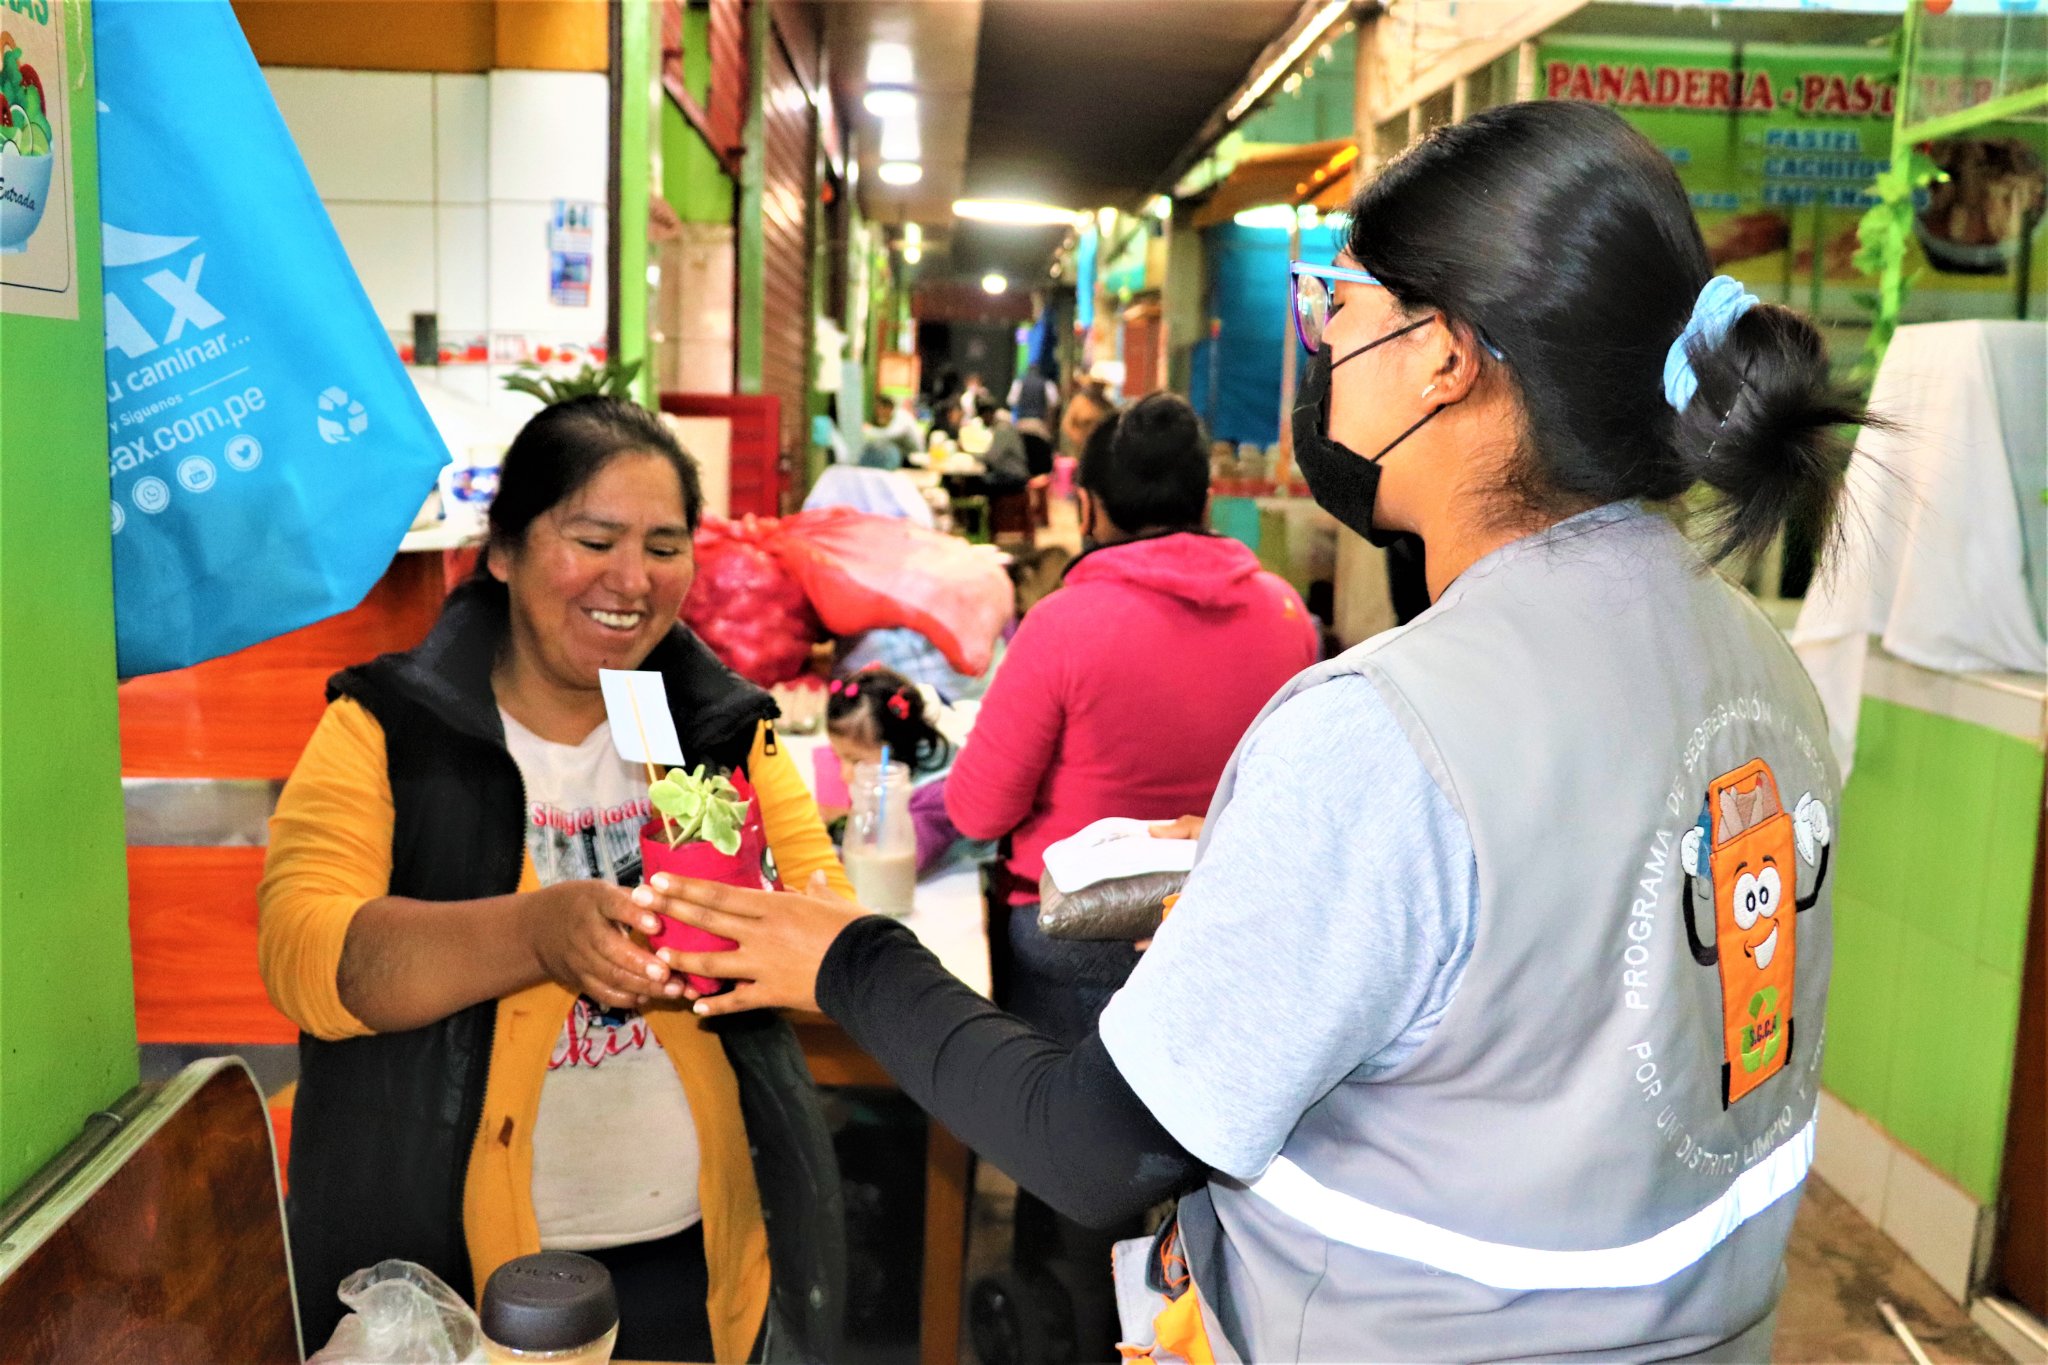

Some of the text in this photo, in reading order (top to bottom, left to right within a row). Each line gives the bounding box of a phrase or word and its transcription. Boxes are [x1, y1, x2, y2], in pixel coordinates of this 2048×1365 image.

[1546, 62, 1774, 110] PANADERIA
[126, 332, 251, 392] caminar...
[1623, 829, 1673, 1010] PROGRAMA
[1666, 774, 1685, 816] DE
[1627, 1041, 1662, 1102] POR
[1656, 1104, 1684, 1141] UN
[1743, 1105, 1793, 1165] LIMPIO
